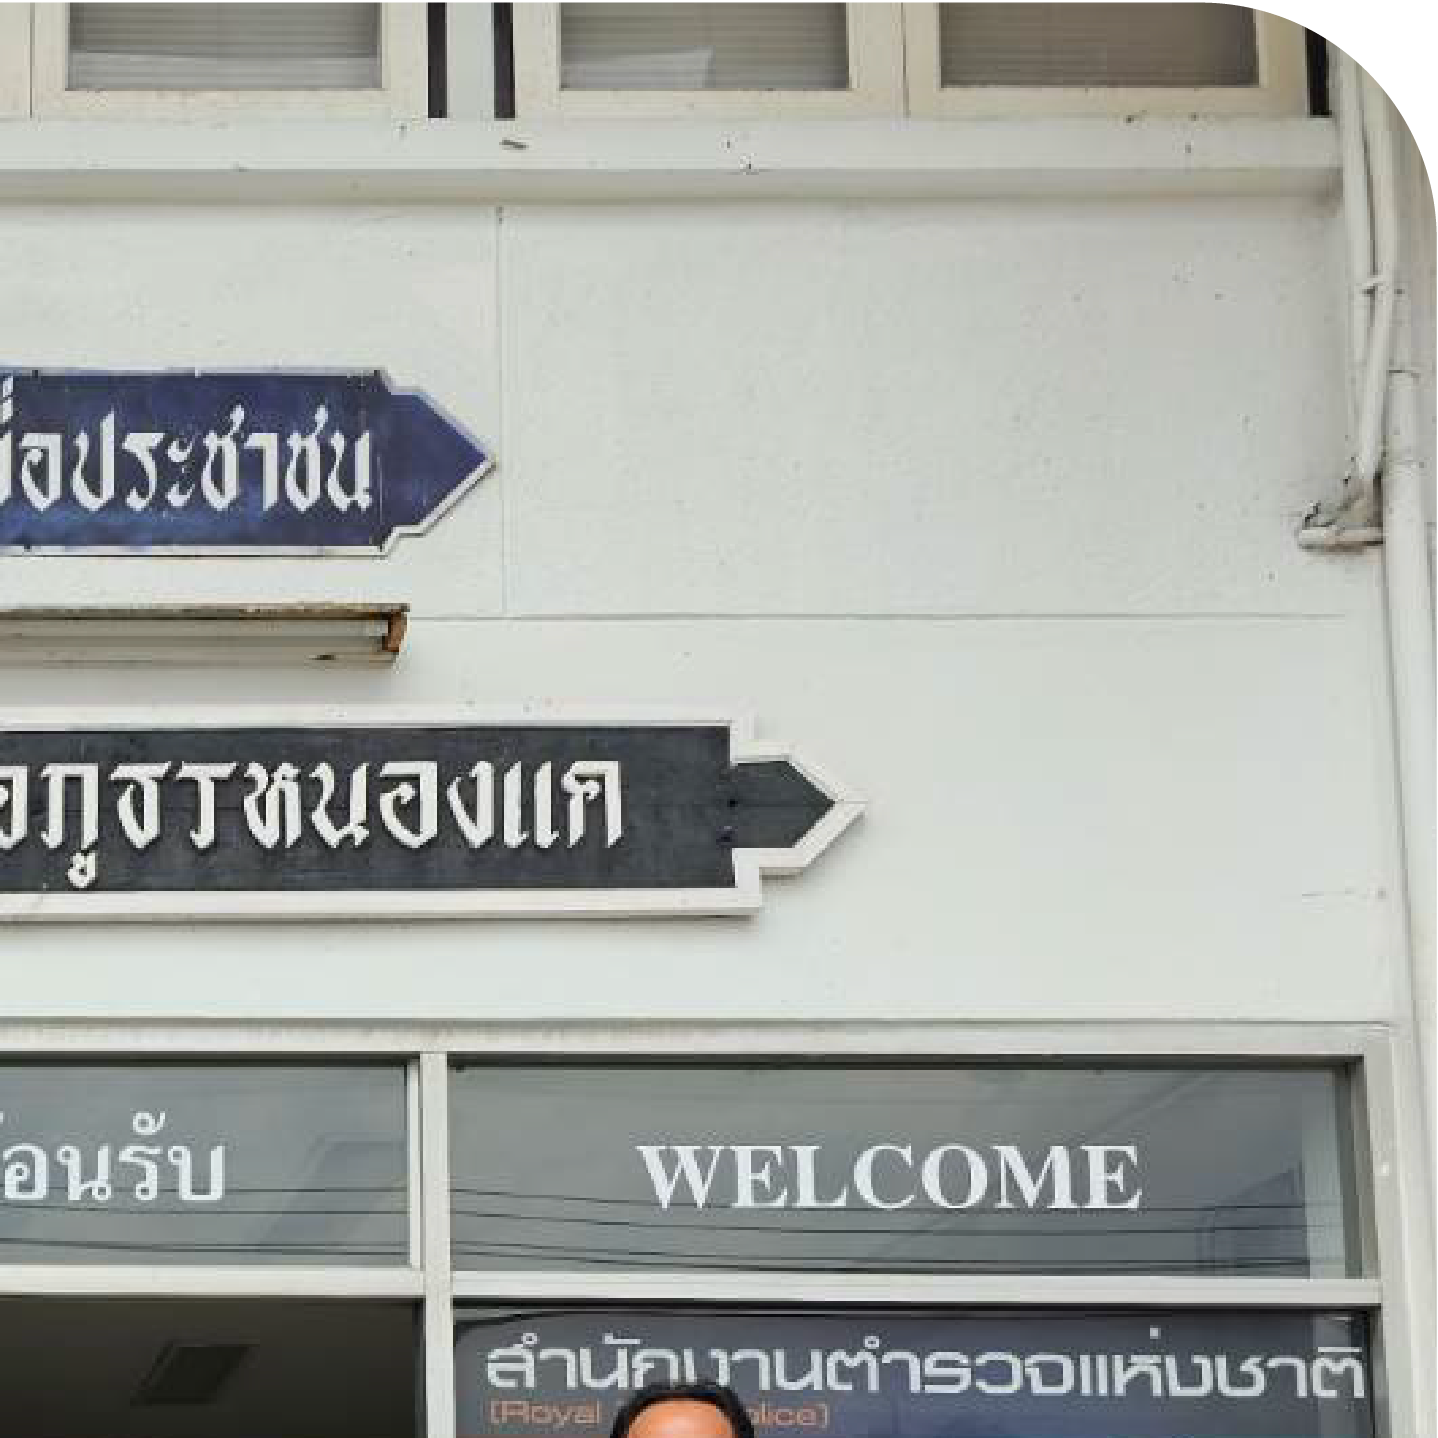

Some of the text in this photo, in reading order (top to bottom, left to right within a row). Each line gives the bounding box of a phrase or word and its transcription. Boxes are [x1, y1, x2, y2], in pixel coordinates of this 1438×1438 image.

[637, 1143, 1142, 1211] WELCOME
[487, 1328, 1365, 1399] สำนักงานตำรวจแห่งชาติ
